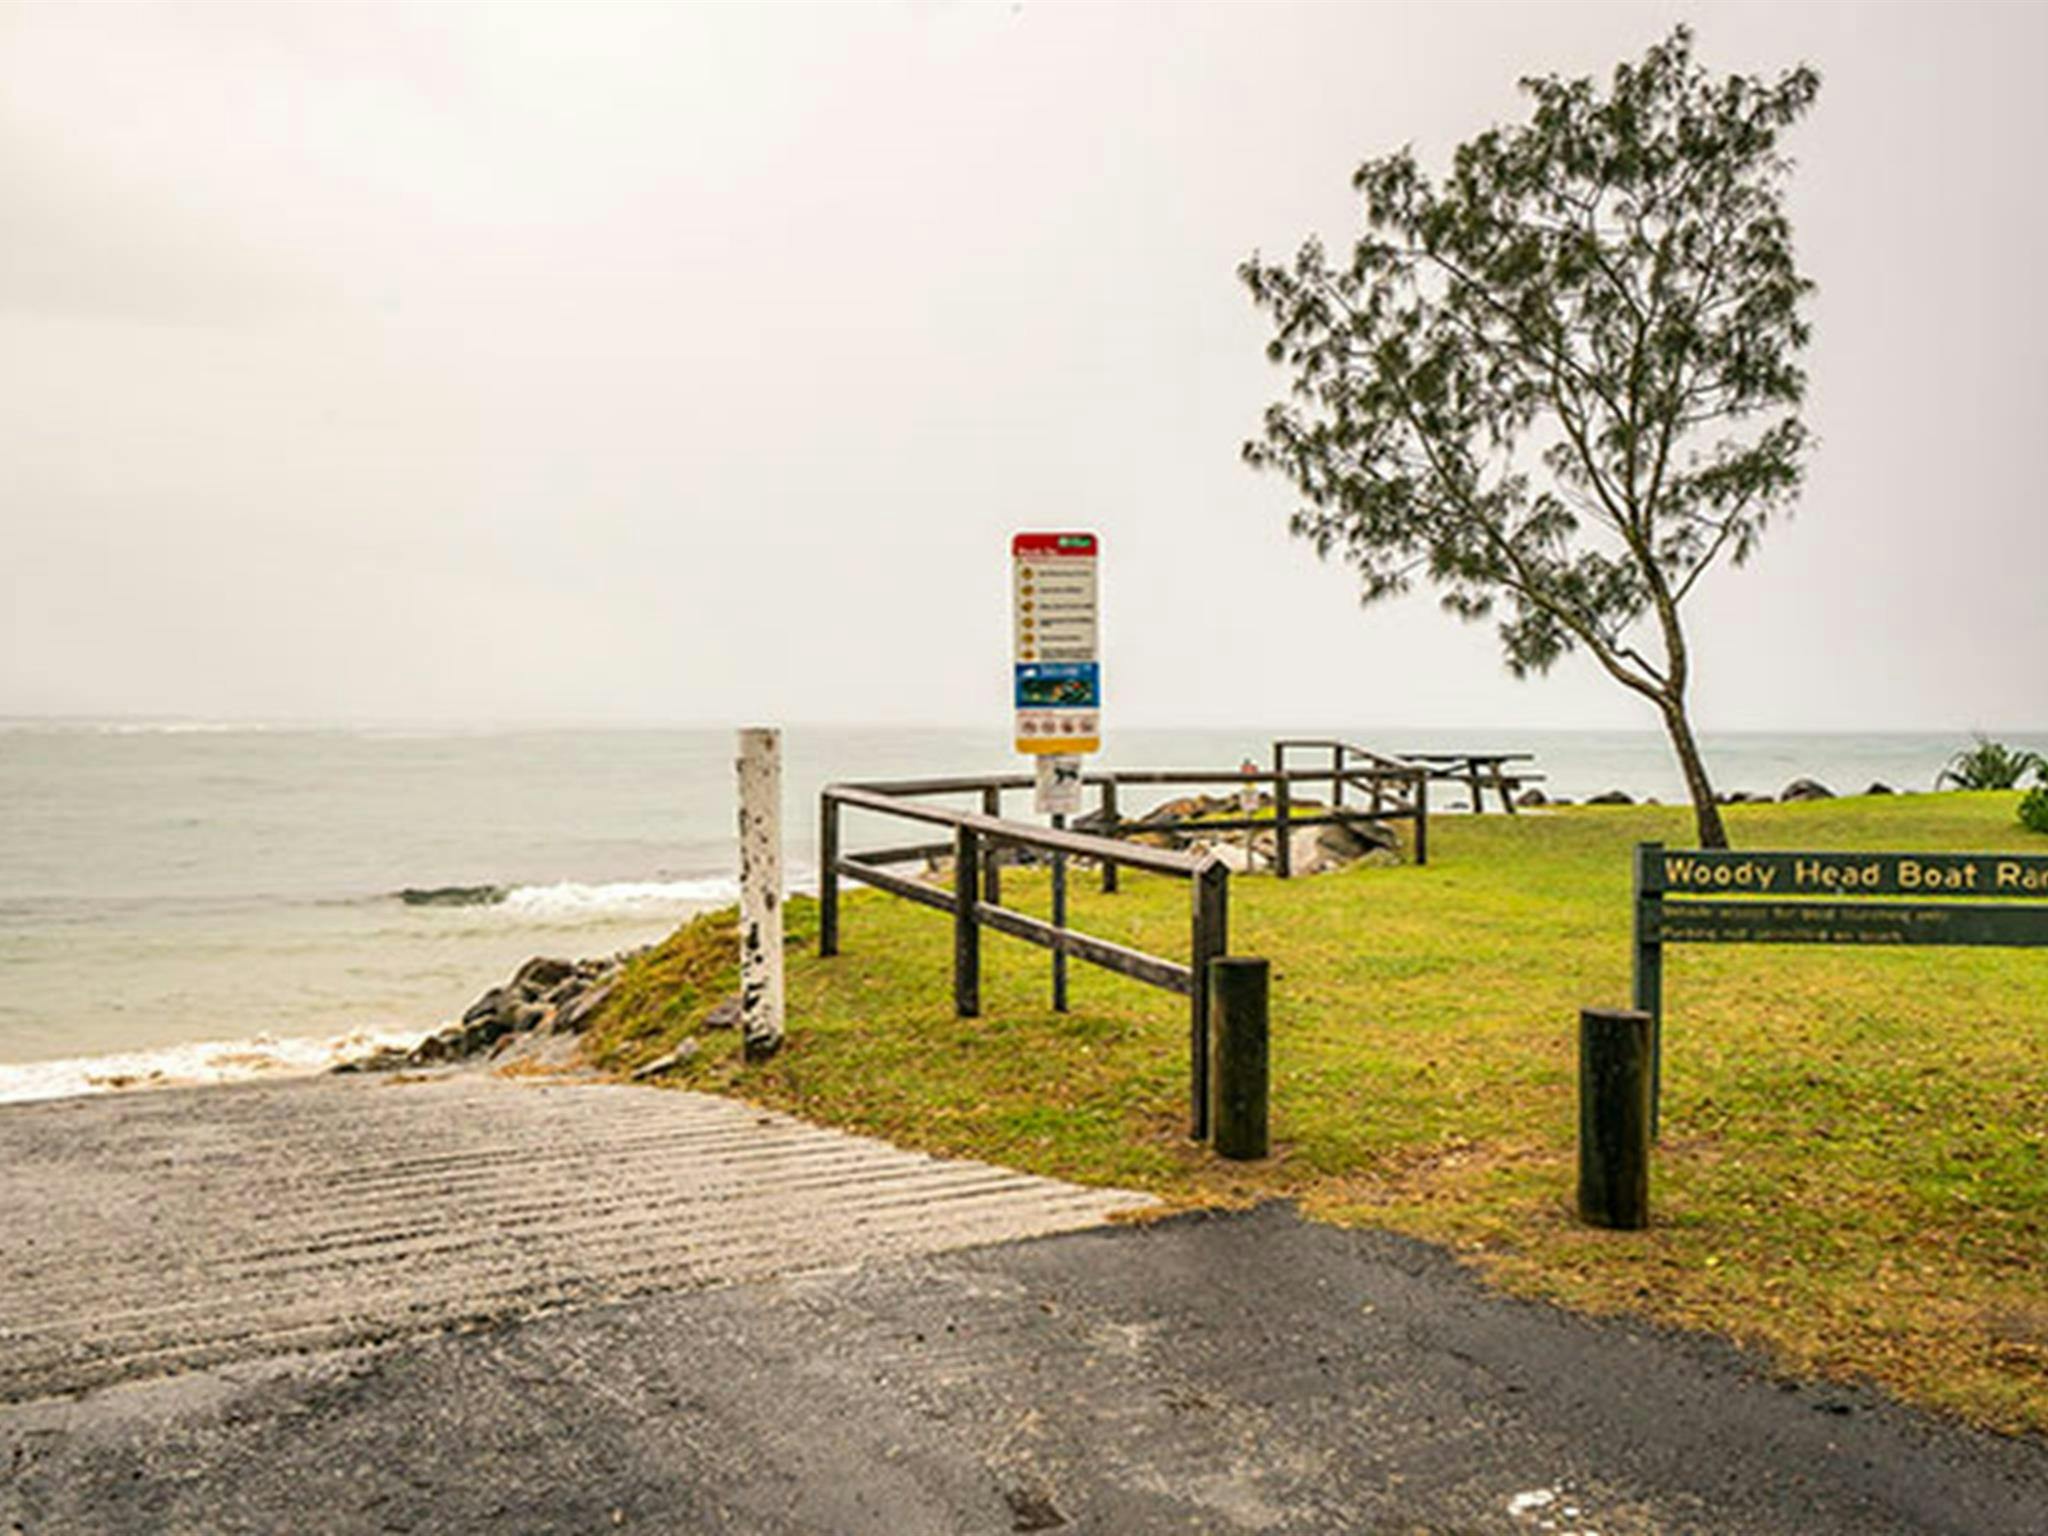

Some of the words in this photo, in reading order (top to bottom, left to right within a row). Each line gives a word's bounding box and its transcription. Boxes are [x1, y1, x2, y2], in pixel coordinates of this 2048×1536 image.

[1664, 857, 1776, 890] Woody
[1794, 859, 1880, 887] Head
[1898, 860, 1978, 887] Boat
